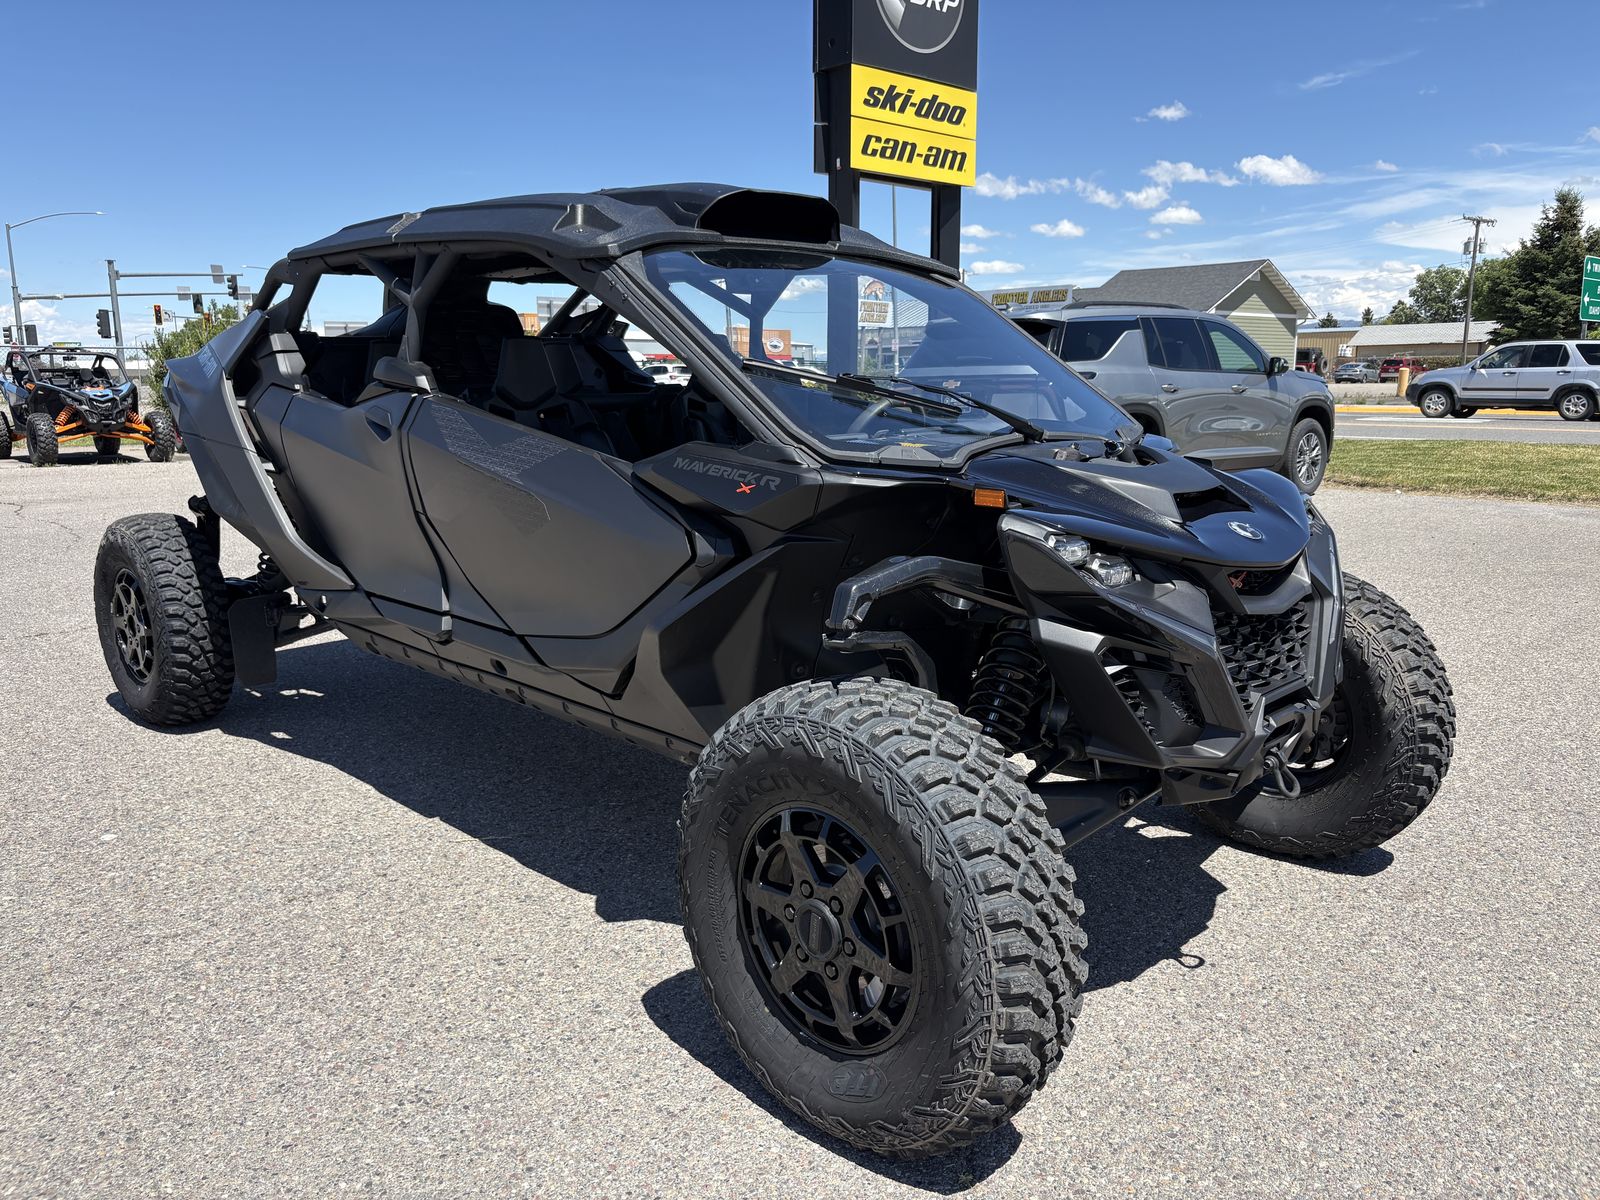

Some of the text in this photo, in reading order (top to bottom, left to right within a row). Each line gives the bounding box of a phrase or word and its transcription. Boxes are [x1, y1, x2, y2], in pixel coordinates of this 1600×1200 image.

[909, 0, 960, 13] RP
[862, 84, 967, 127] ski-doo
[860, 134, 967, 172] can-am
[673, 456, 782, 491] MAVERICK R
